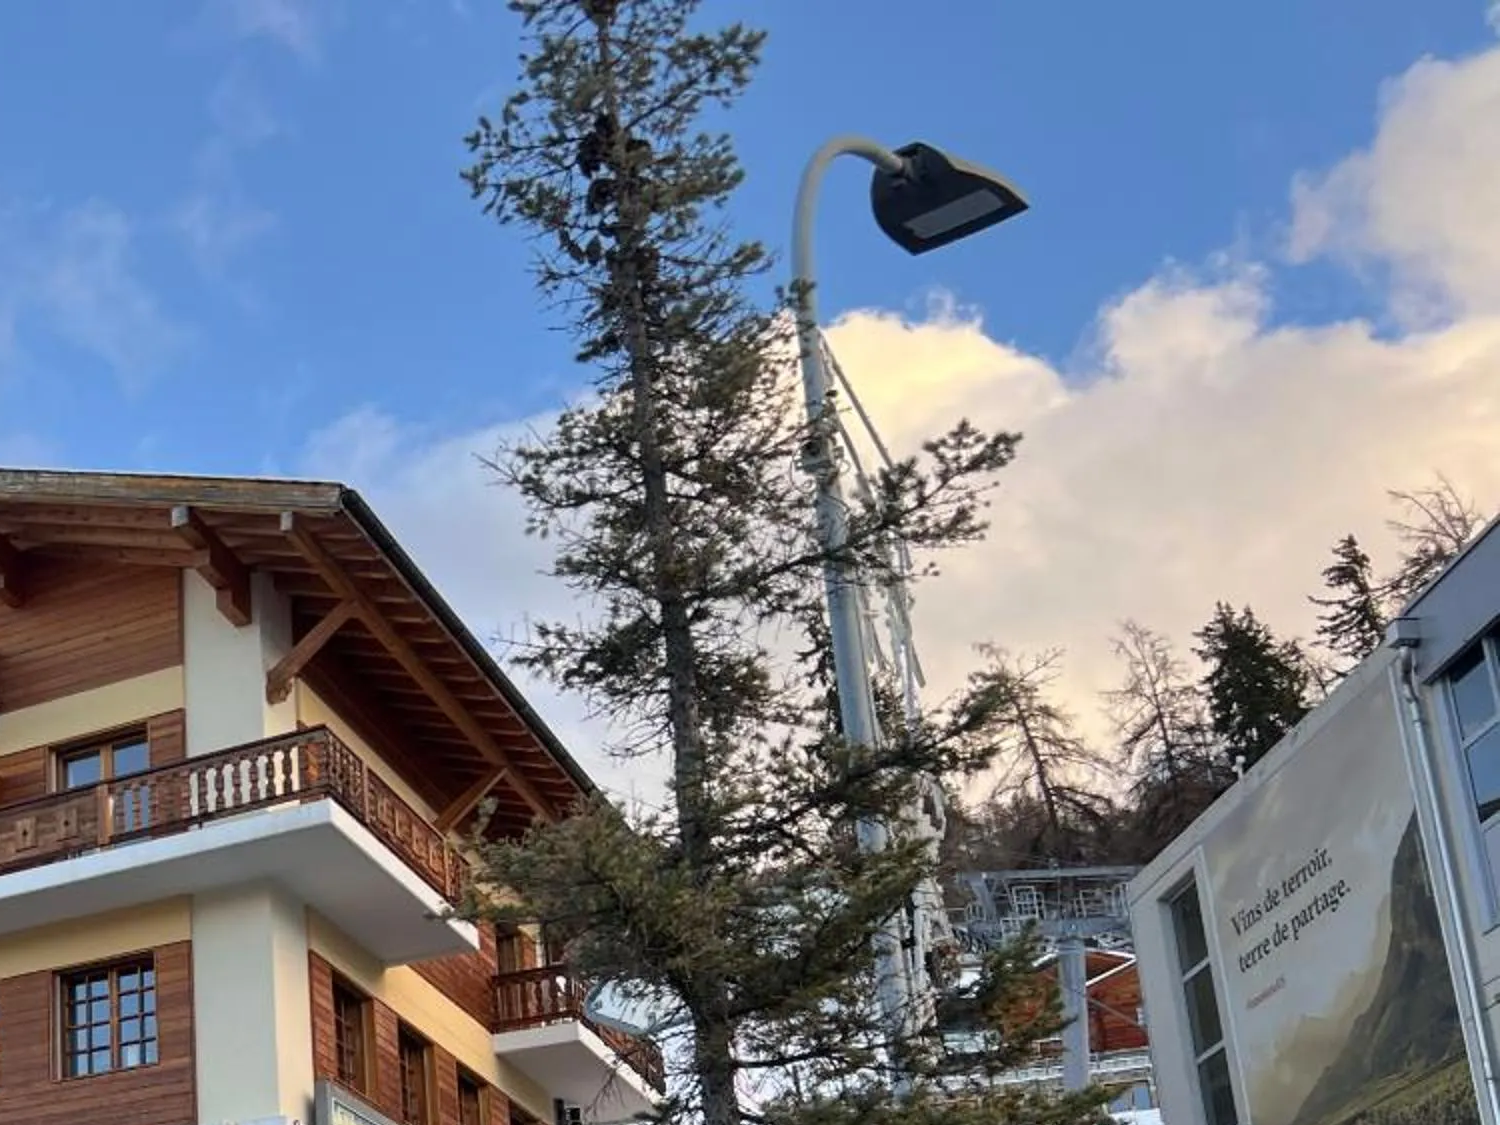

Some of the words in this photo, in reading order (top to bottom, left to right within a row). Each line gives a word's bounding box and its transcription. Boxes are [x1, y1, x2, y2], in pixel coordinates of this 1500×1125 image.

[1230, 903, 1263, 936] Vins
[1263, 887, 1280, 913] de
[1281, 848, 1333, 898] terroir.
[1238, 936, 1271, 974] terre
[1272, 921, 1289, 948] de
[1290, 878, 1352, 942] partage.
